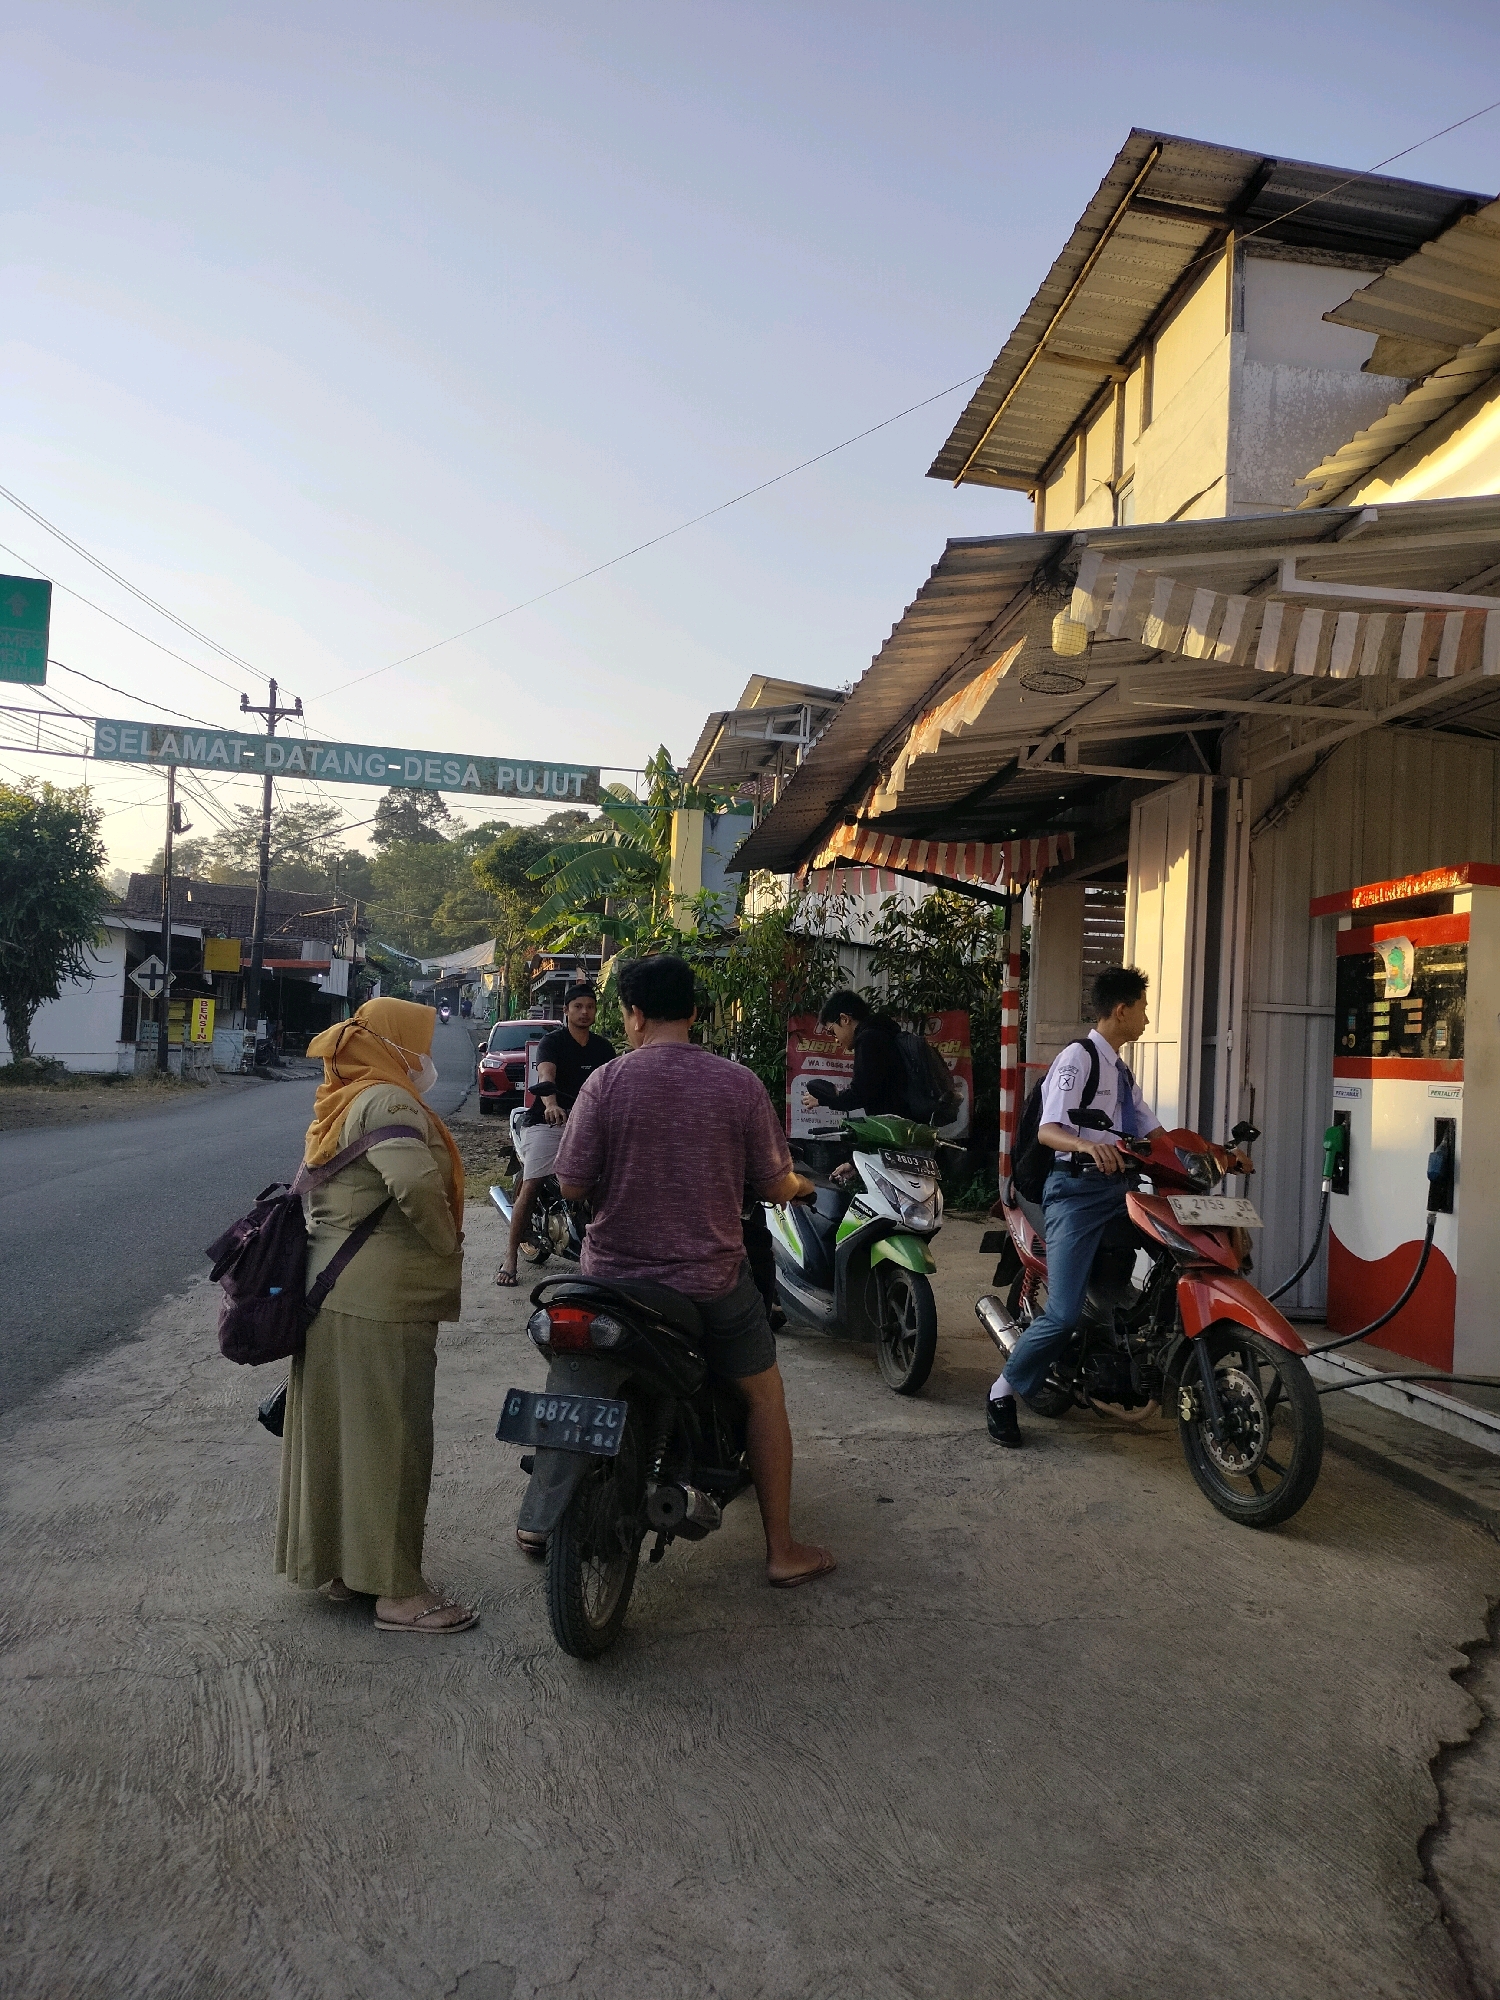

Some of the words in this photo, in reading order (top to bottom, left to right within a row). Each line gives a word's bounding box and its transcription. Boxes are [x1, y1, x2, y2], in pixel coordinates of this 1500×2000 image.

[497, 766, 588, 797] PUJUT
[196, 1000, 208, 1040] BENSIN
[1430, 1090, 1460, 1098] PERTALITE
[1173, 1198, 1182, 1210] G
[508, 1397, 521, 1416] G
[535, 1399, 582, 1423] 6874
[592, 1405, 620, 1429] ZC
